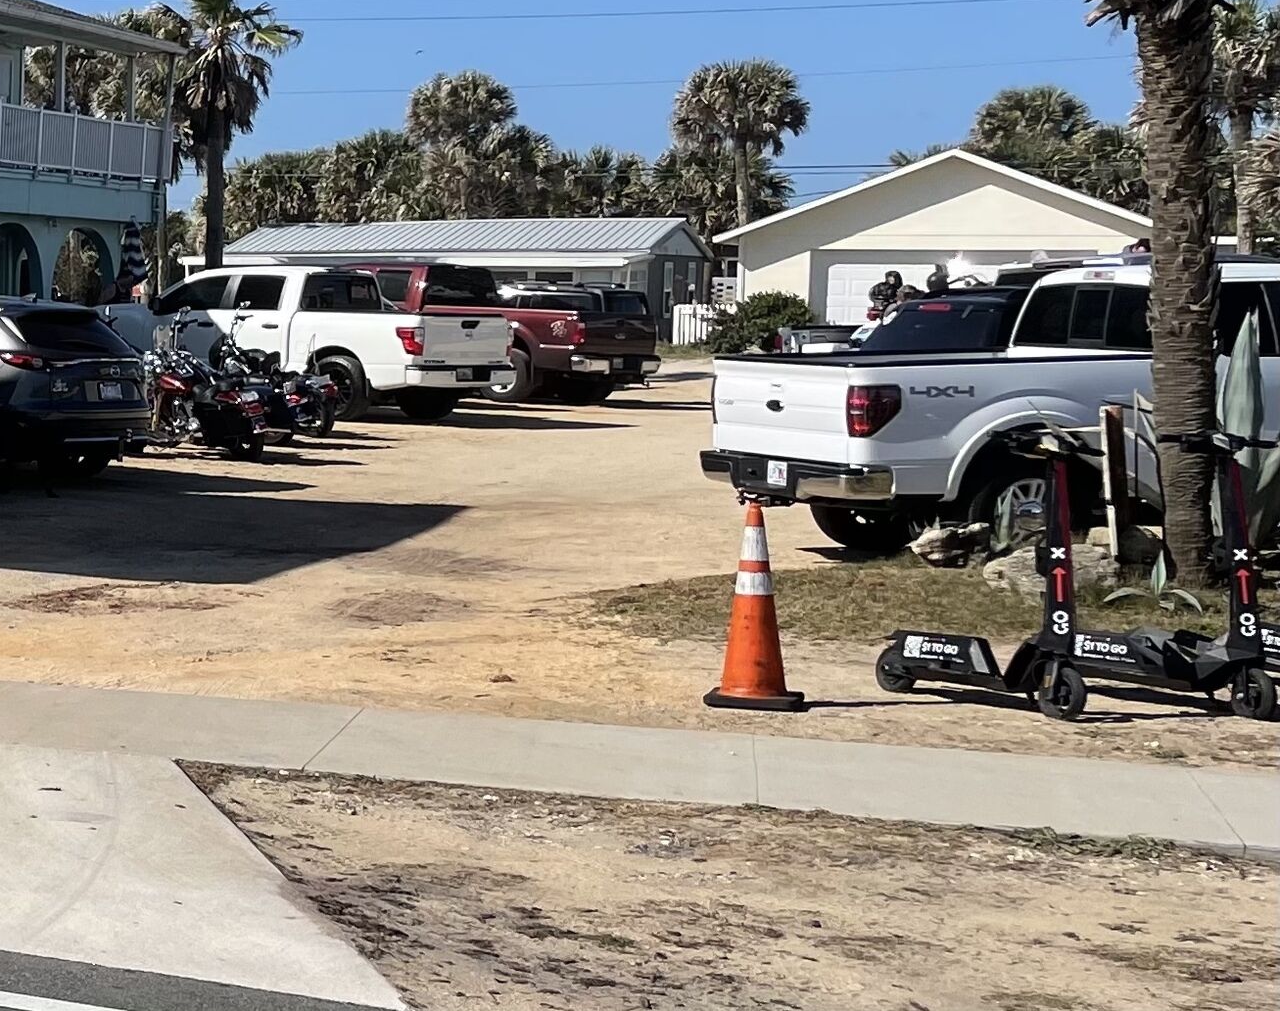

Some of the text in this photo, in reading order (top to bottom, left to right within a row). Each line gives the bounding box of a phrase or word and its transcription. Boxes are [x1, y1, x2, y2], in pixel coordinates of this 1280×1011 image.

[909, 385, 975, 398] 4X4
[1052, 610, 1069, 635] GO
[1240, 613, 1256, 637] GO
[931, 643, 944, 653] TO
[944, 644, 959, 655] GO
[1095, 642, 1110, 653] TO
[1110, 644, 1128, 655] GO
